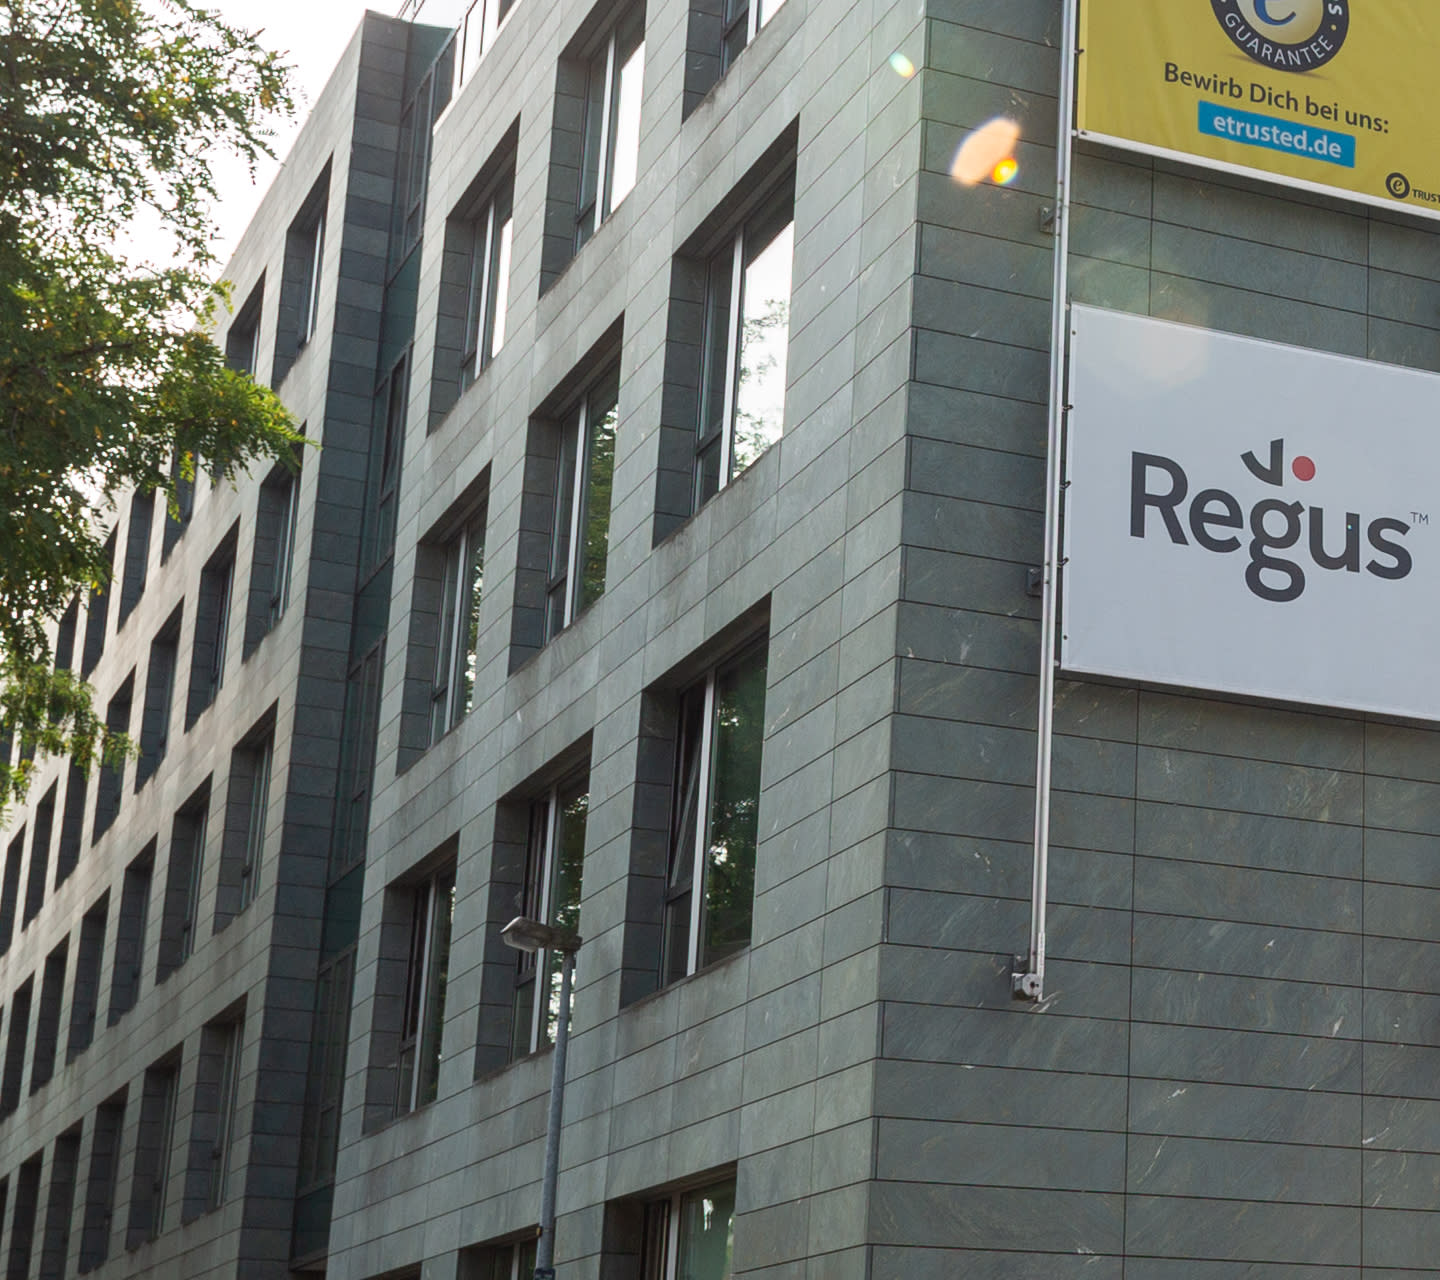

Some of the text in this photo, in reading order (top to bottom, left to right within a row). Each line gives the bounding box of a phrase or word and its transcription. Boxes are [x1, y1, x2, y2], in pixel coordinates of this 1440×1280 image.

[1224, 12, 1334, 66] GUARANTEE
[1164, 61, 1389, 134] Bewirb Dich bei uns:
[1213, 114, 1343, 160] etrusted.de
[1129, 449, 1413, 603] Regus
